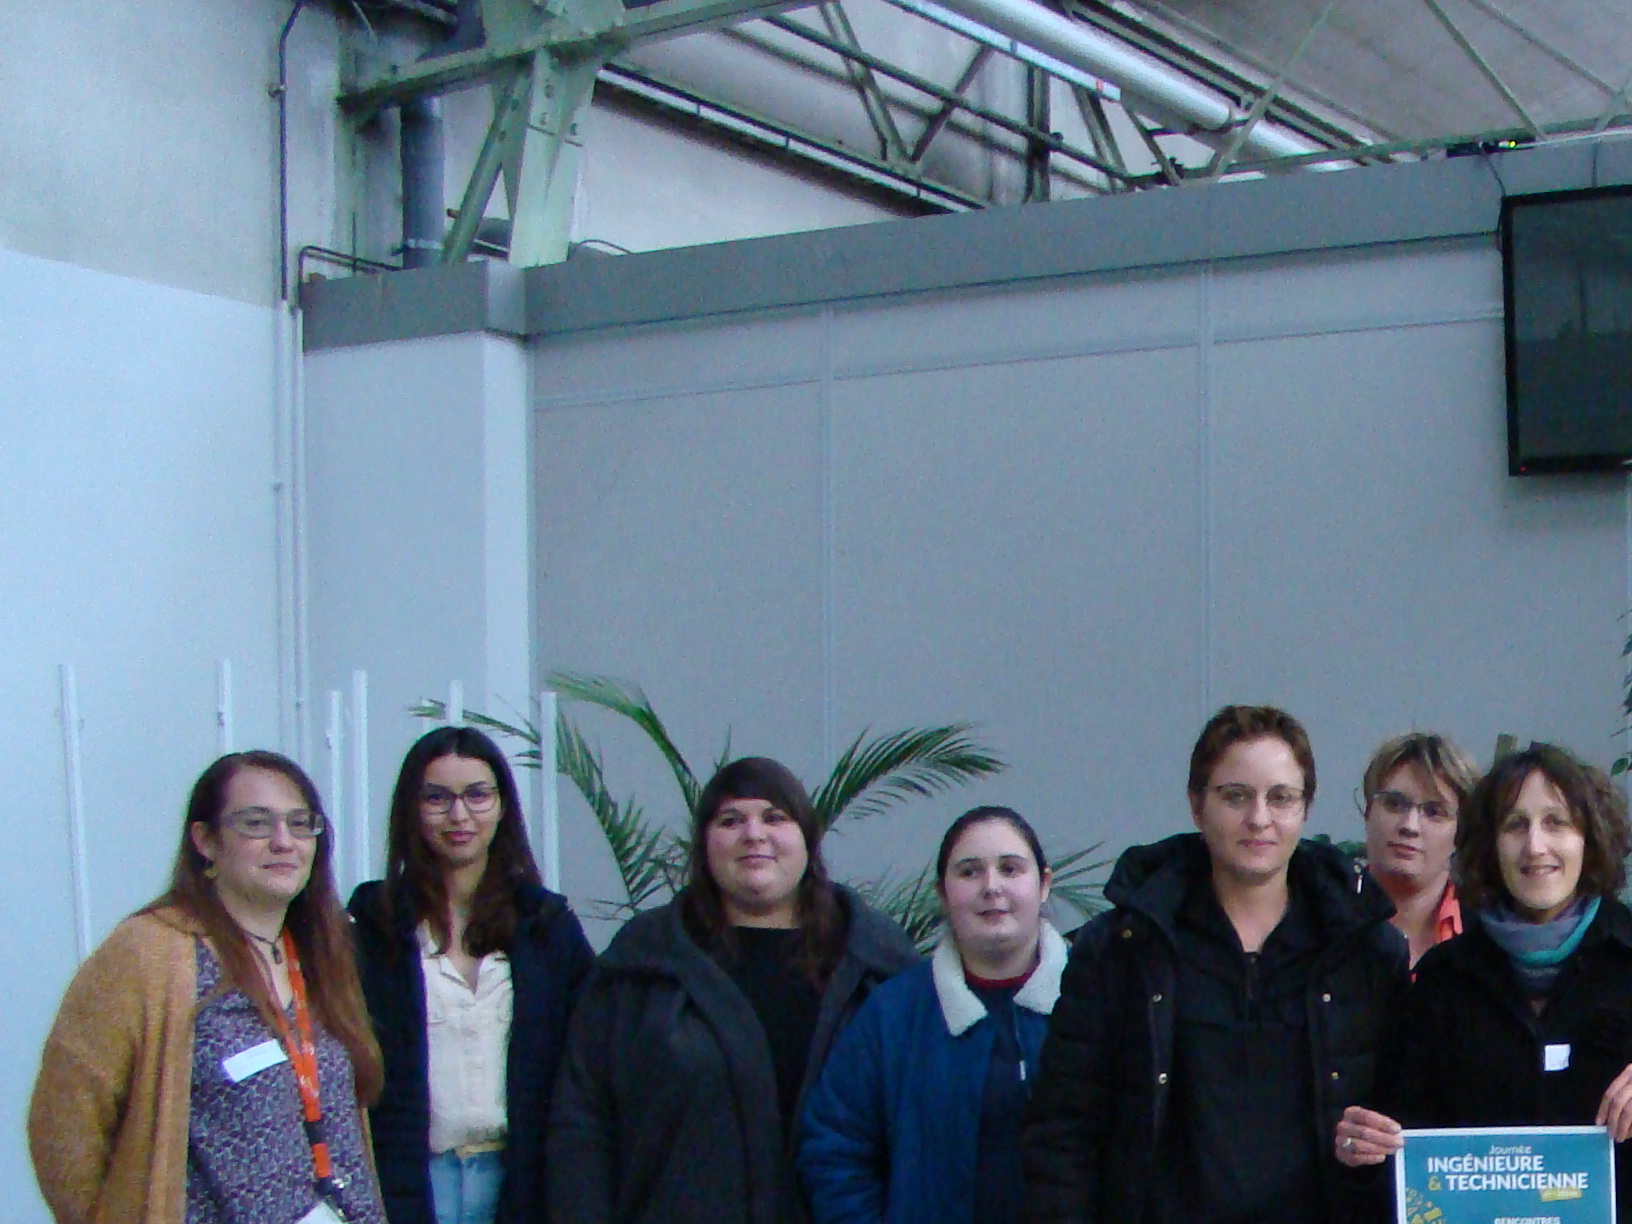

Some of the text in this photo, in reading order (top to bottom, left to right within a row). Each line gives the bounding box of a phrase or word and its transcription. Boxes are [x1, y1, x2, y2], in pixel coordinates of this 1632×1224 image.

[1427, 1153, 1544, 1173] INGÉNIEURE
[1428, 1172, 1589, 1191] & TECHNICIENNE
